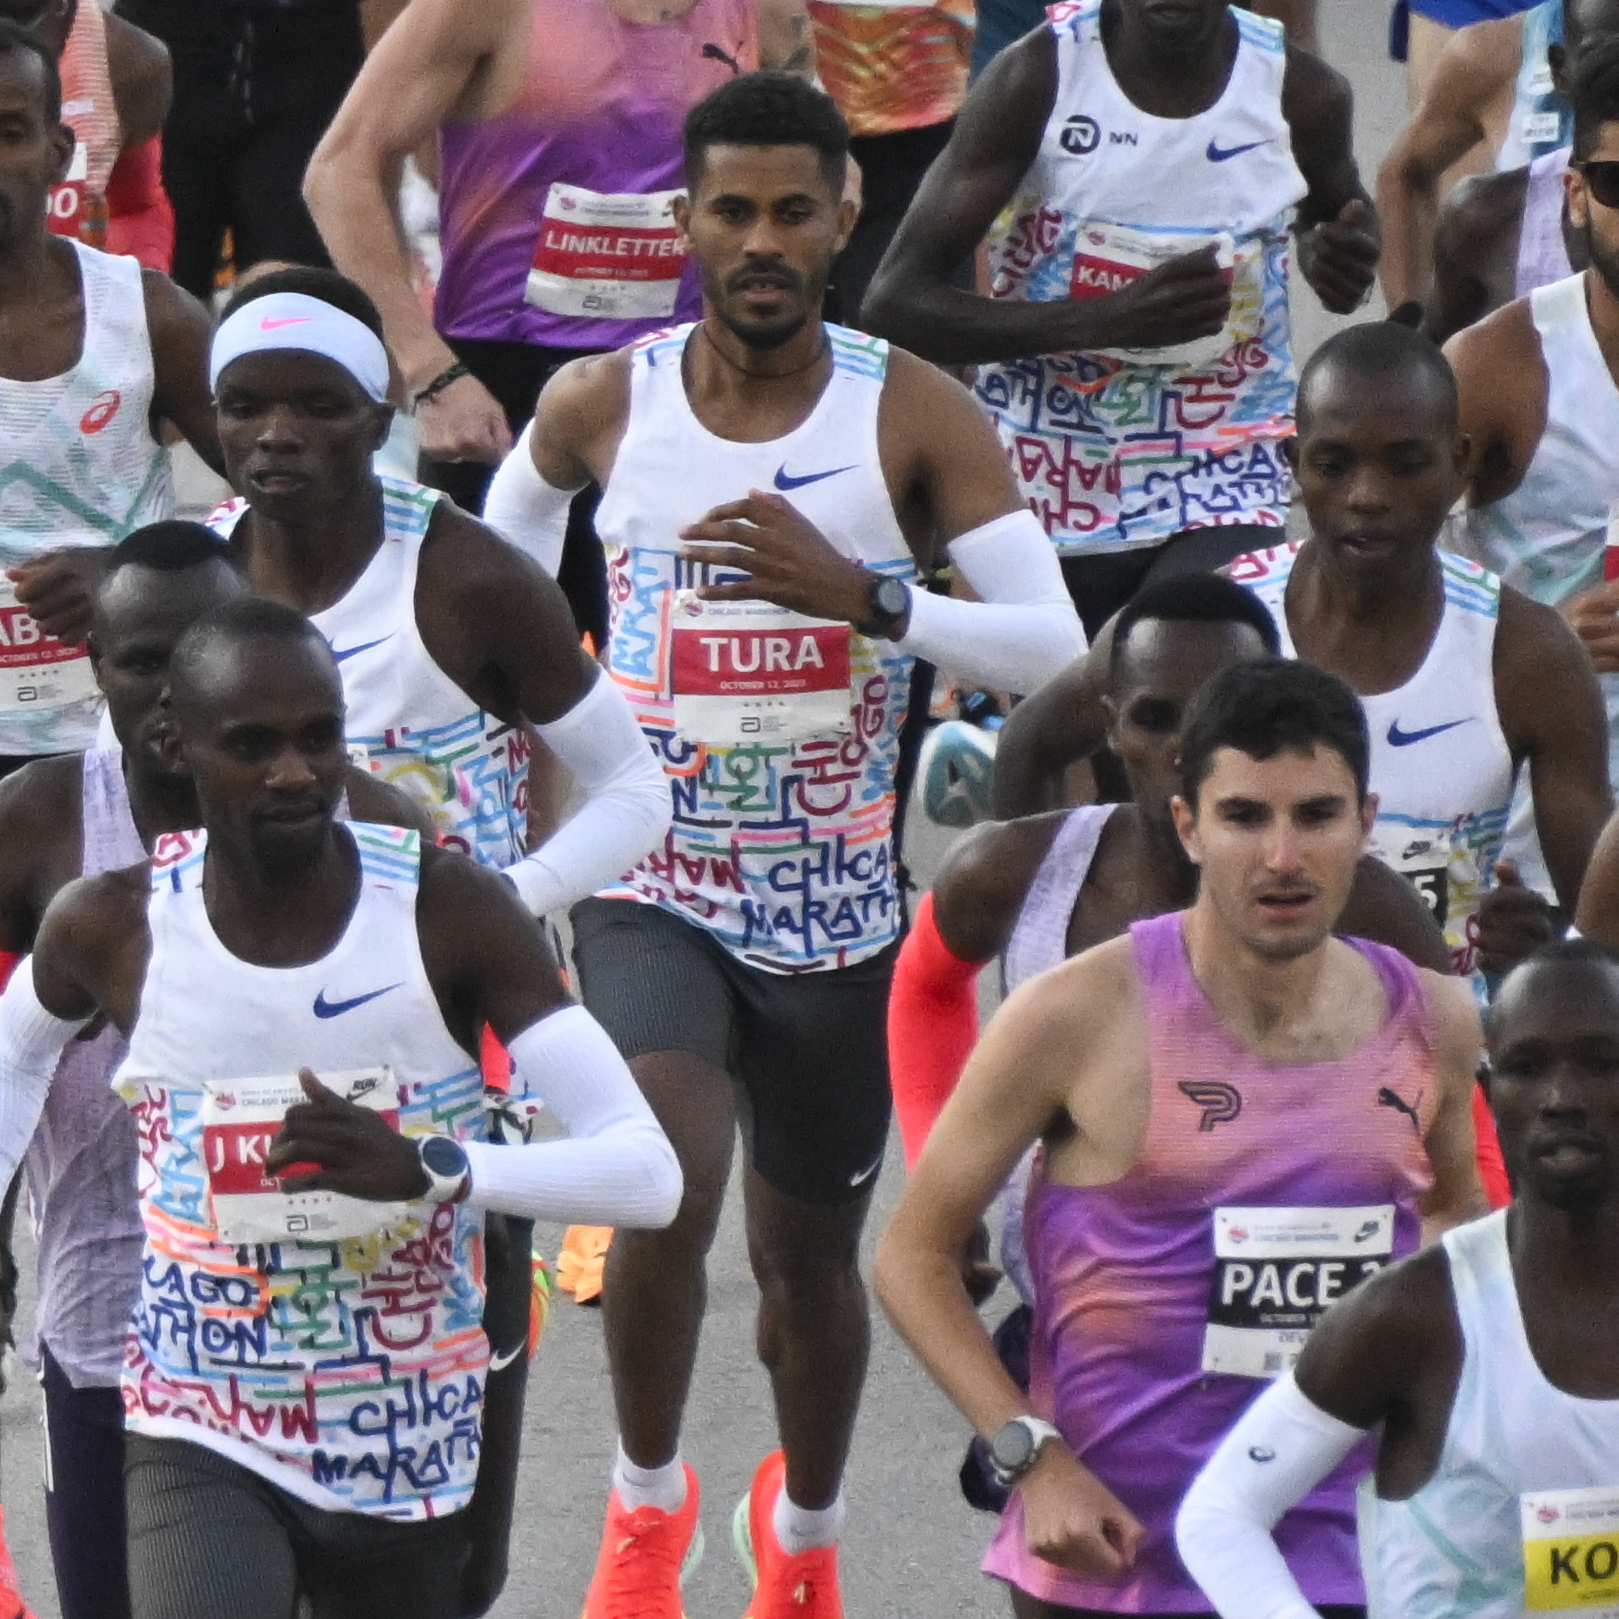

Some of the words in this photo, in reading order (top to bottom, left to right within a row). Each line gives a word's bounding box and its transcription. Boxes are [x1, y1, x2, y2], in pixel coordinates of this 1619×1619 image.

[699, 635, 826, 673] TURA
[211, 1136, 226, 1173] J
[1221, 1261, 1347, 1309] PACE
